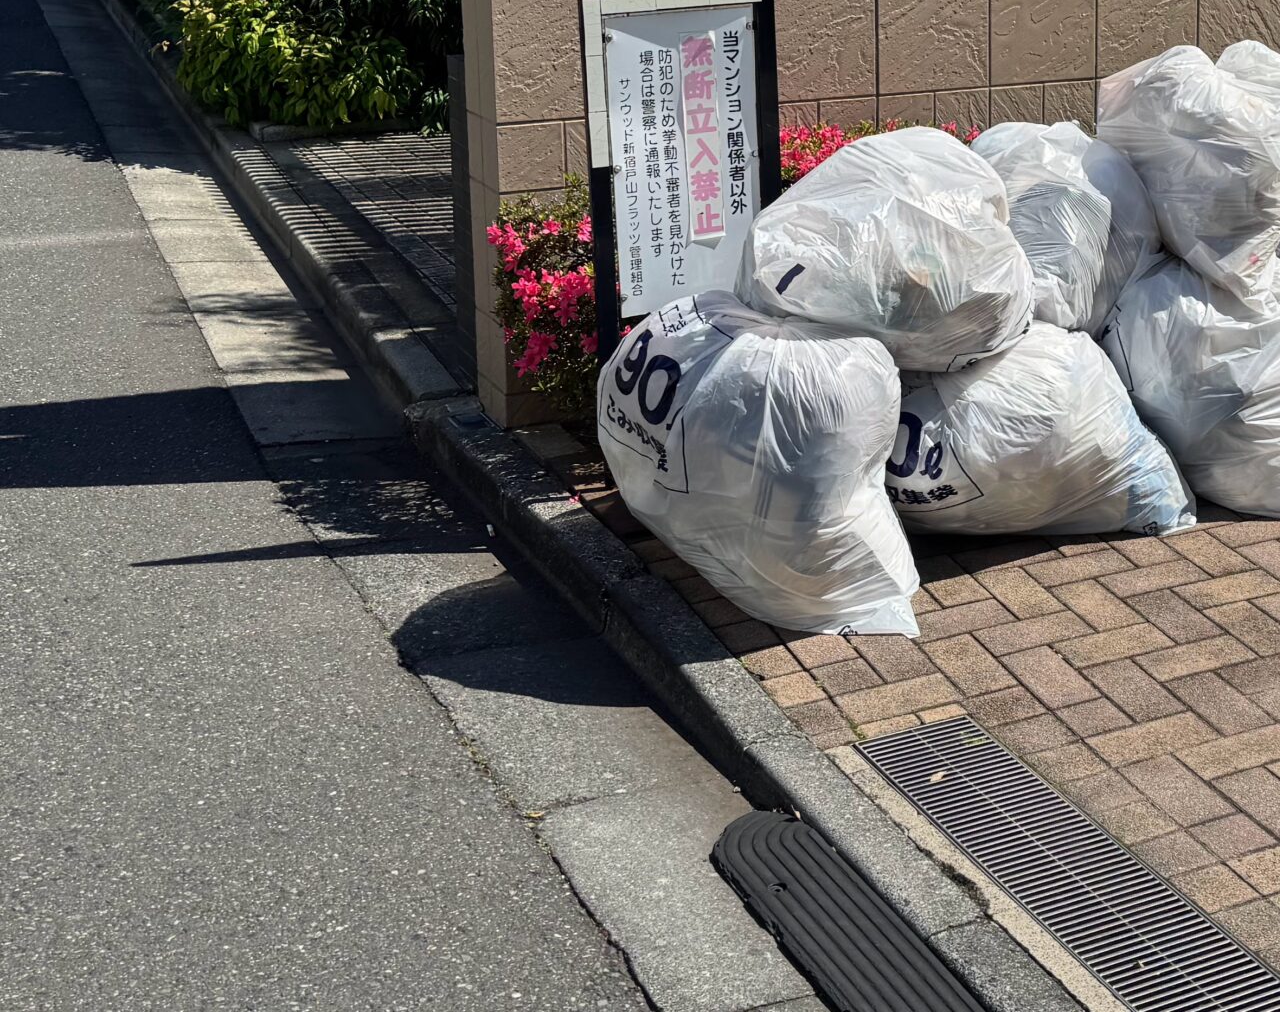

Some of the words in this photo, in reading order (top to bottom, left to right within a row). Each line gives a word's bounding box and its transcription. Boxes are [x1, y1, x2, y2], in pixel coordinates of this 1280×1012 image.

[619, 77, 643, 297] サンウッド新宿戸山フラッツ管理組合
[640, 50, 664, 257] 場合は警察に通報いたします
[658, 49, 685, 286] 防犯のため挙動不審者を見かけた
[681, 35, 724, 235] 無断立入禁止
[723, 30, 747, 215] 当マンション関係者以外
